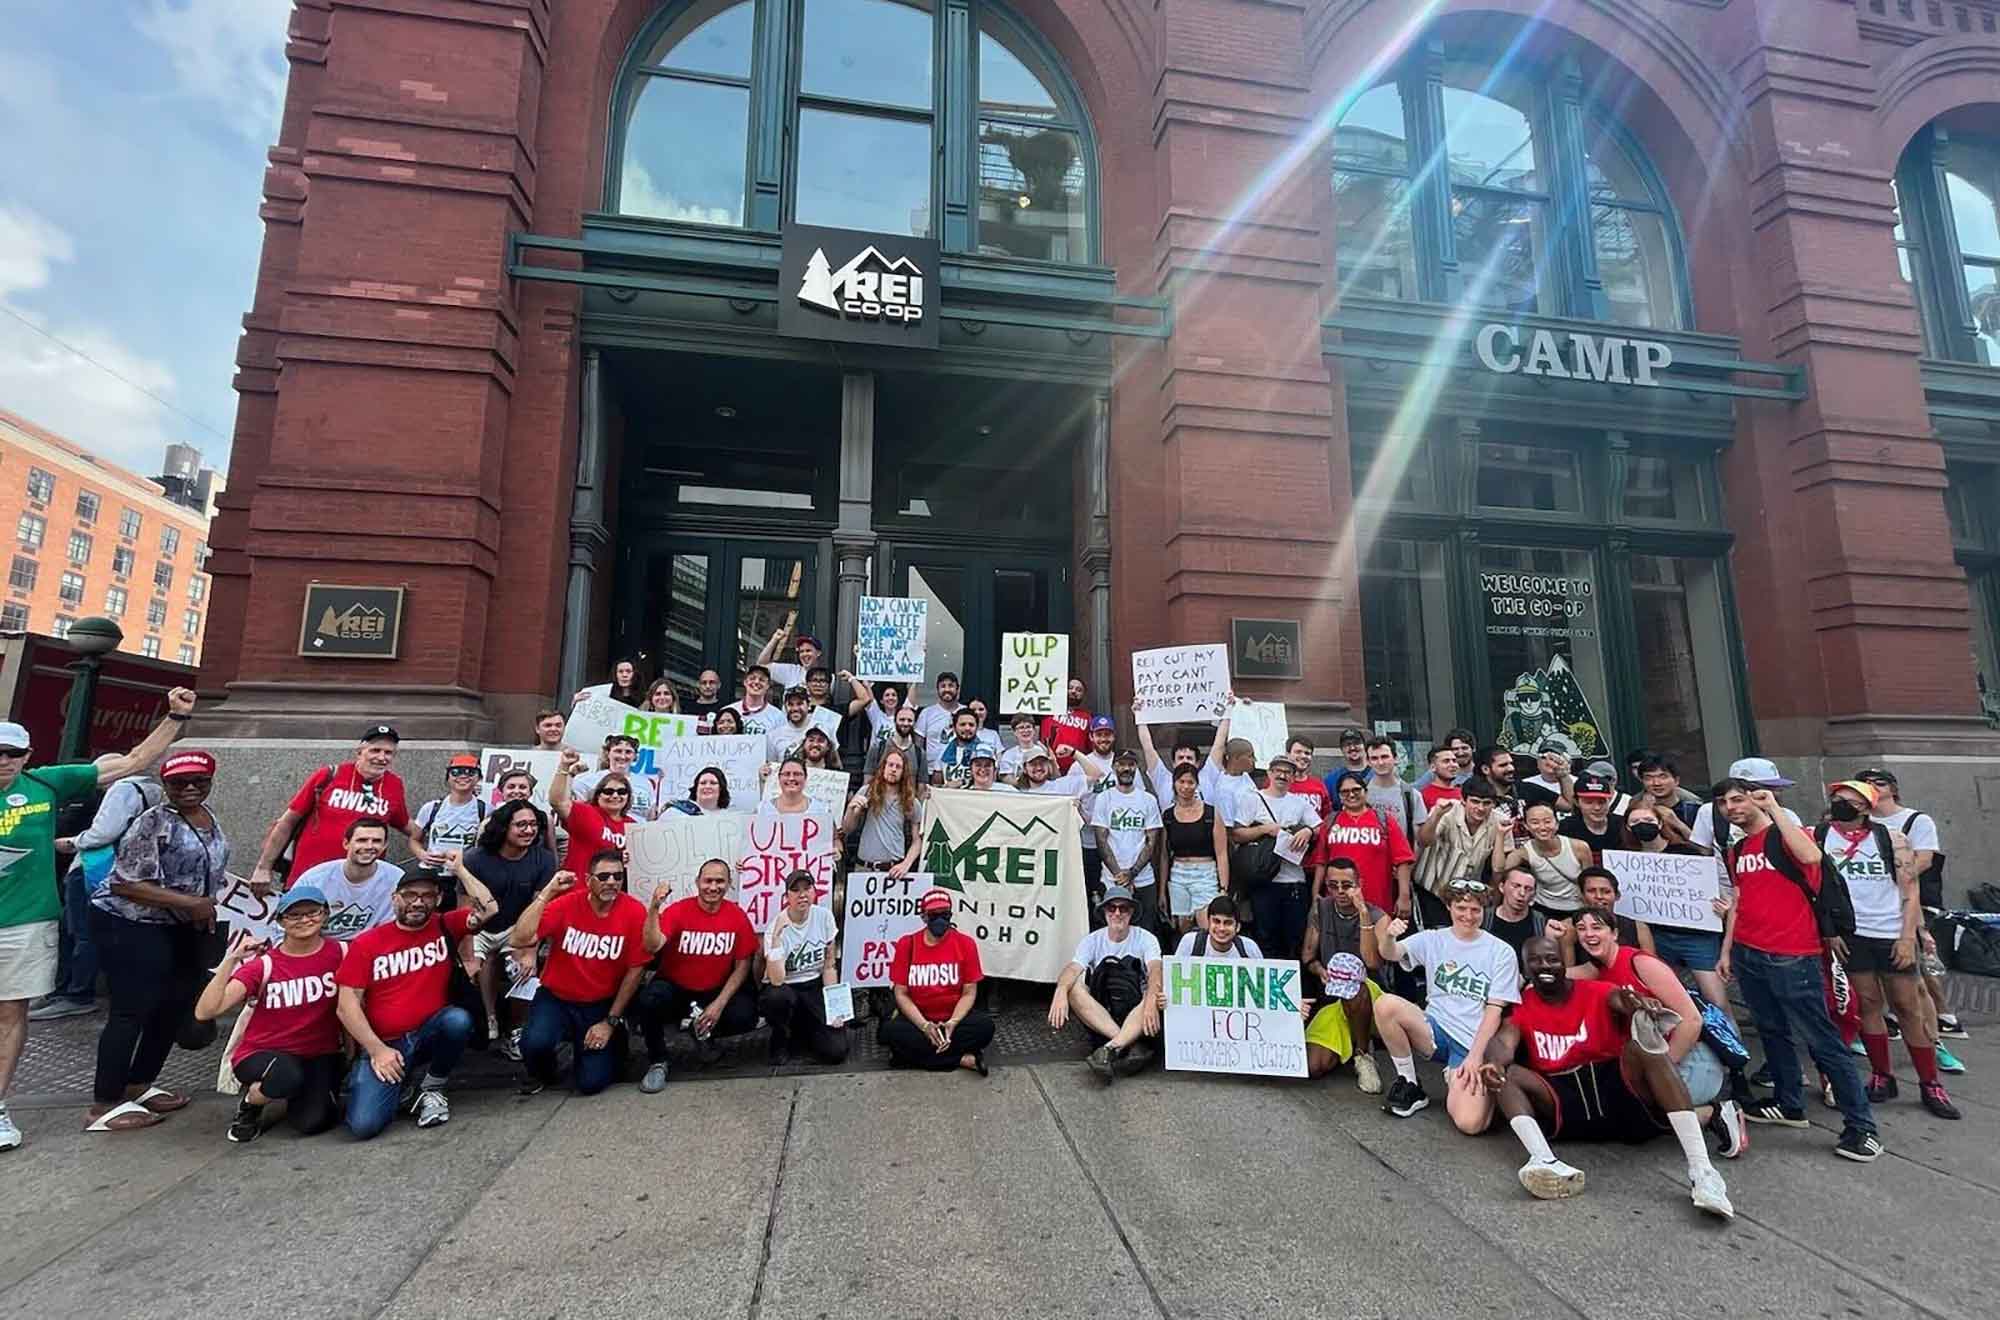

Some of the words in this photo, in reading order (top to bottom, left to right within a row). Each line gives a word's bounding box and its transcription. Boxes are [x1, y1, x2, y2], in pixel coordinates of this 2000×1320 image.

[844, 271, 923, 306] REI
[1476, 323, 1673, 387] CAMP
[1480, 573, 1568, 596] WELCOME
[1572, 579, 1593, 597] TO
[1491, 597, 1527, 615] THE
[1530, 599, 1585, 617] CO-OP
[340, 615, 385, 632] REI
[883, 614, 891, 627] A
[893, 613, 920, 628] LIFE
[902, 652, 910, 662] A
[1013, 636, 1058, 658] ULP
[1164, 654, 1186, 665] CUT
[1194, 650, 1215, 663] MY
[859, 661, 893, 675] LIVING
[1024, 662, 1040, 678] U
[1138, 670, 1162, 685] PAY
[1007, 677, 1058, 695] PAY
[1136, 684, 1182, 696] AFFORD
[1016, 696, 1052, 711] ME
[624, 713, 686, 747] REI
[666, 742, 695, 761] AN
[698, 740, 755, 757] INJURY
[1122, 816, 1145, 828] REI
[750, 818, 819, 852] ULP
[1328, 826, 1381, 846] RWDSU
[964, 846, 1059, 887] REI
[1607, 853, 1703, 876] WORKERS
[865, 876, 915, 896] OPT
[1637, 873, 1688, 886] UNITED
[1648, 885, 1682, 899] NEVER
[746, 892, 774, 925] AT
[851, 898, 924, 919] OUTSIDE
[958, 898, 1056, 921] NION
[1632, 896, 1704, 921] DIVIDED
[561, 926, 625, 961] RWDSU
[678, 930, 736, 956] RWDSU
[949, 922, 1040, 945] OHO
[373, 935, 449, 981] RWDSU
[908, 963, 960, 987] RWDSU
[265, 971, 338, 1009] RWDS
[1171, 962, 1300, 1013] HONK
